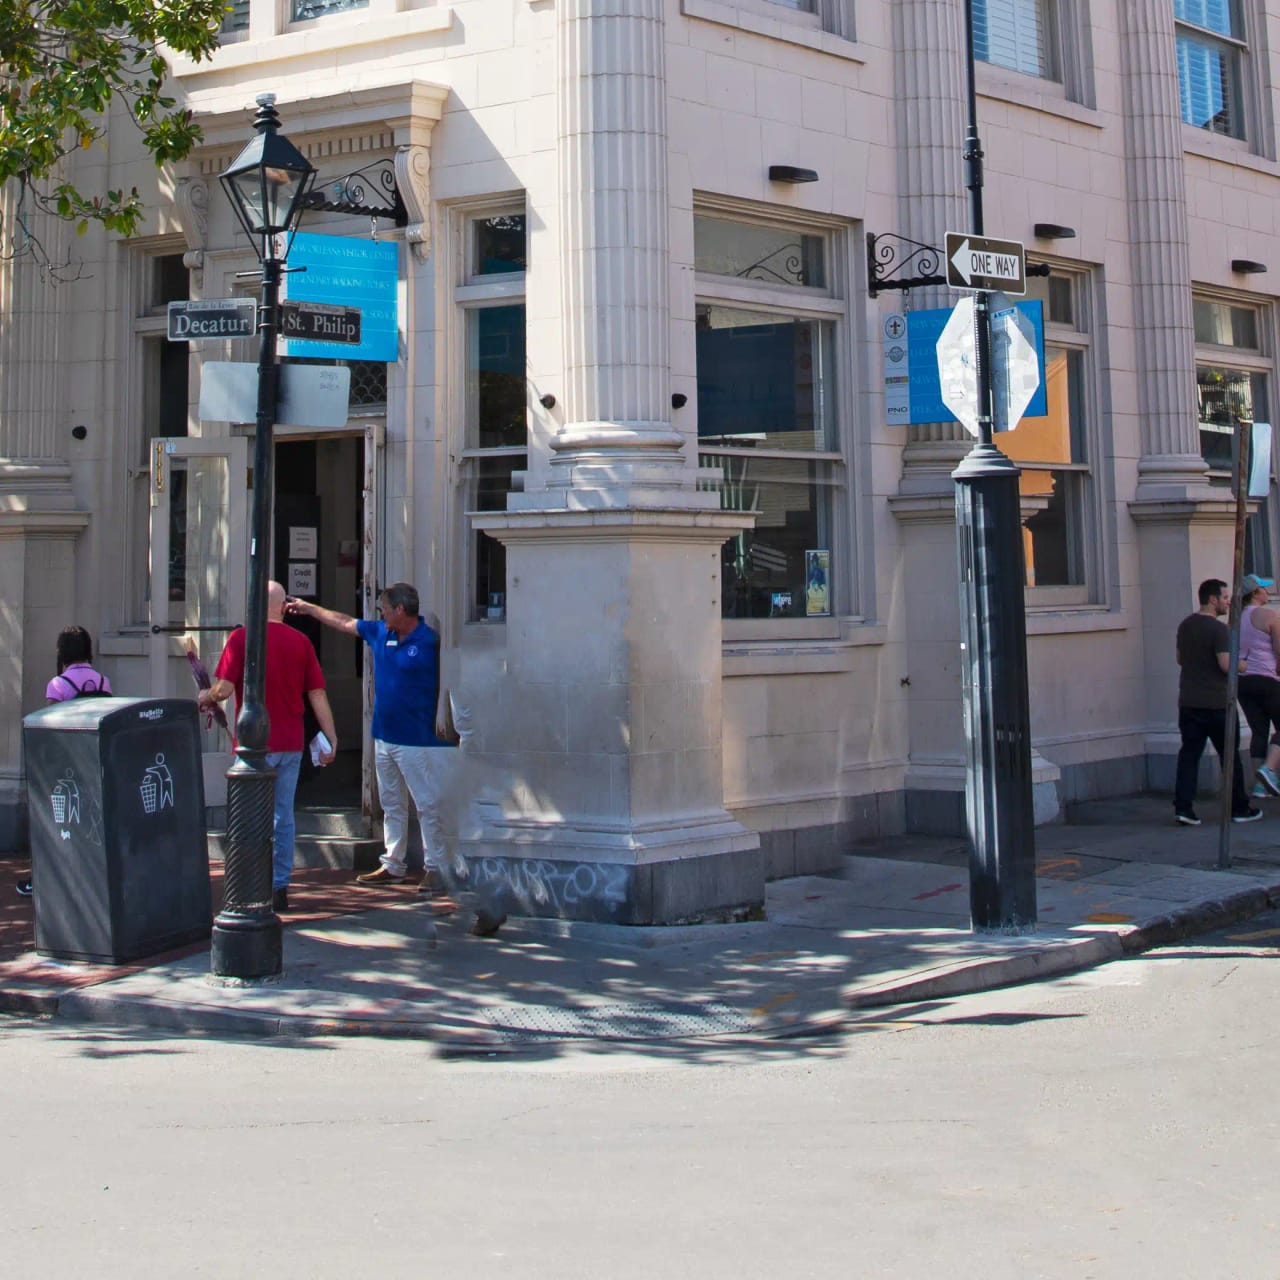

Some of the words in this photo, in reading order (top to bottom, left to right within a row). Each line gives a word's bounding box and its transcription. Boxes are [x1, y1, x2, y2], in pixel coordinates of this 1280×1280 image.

[971, 252, 992, 274] ONE
[995, 255, 1016, 277] WAY
[175, 314, 248, 334] Decatur
[287, 312, 306, 331] St.
[313, 315, 356, 342] Philip
[294, 568, 312, 577] Credit
[295, 580, 309, 590] Only
